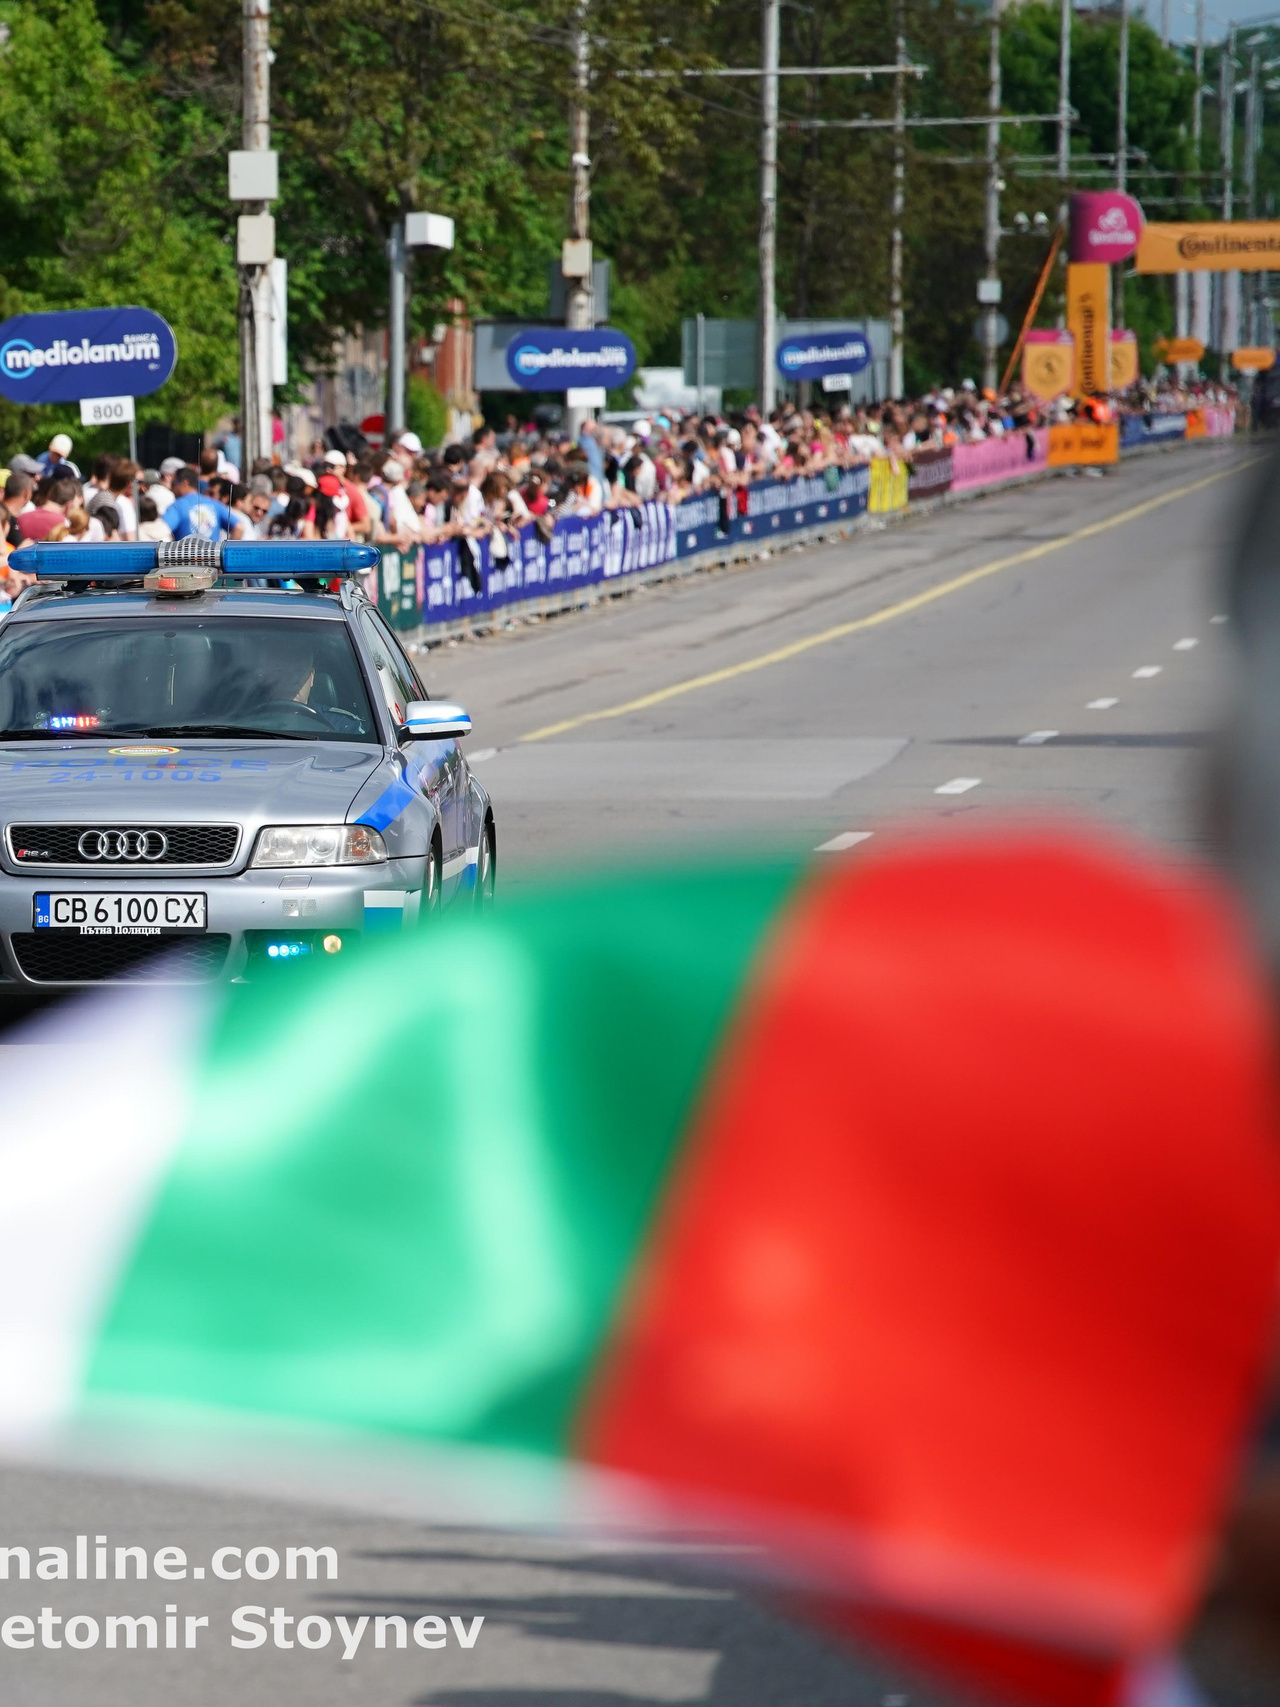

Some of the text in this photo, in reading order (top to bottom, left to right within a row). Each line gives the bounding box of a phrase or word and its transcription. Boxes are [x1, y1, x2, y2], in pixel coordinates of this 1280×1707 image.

[1178, 233, 1280, 260] Continent
[5, 338, 161, 369] mediolanum
[93, 404, 124, 420] 800
[11, 757, 271, 772] POLICE
[47, 769, 222, 784] 24-1005
[38, 915, 49, 923] BG
[80, 926, 161, 936] Пътна Полиция
